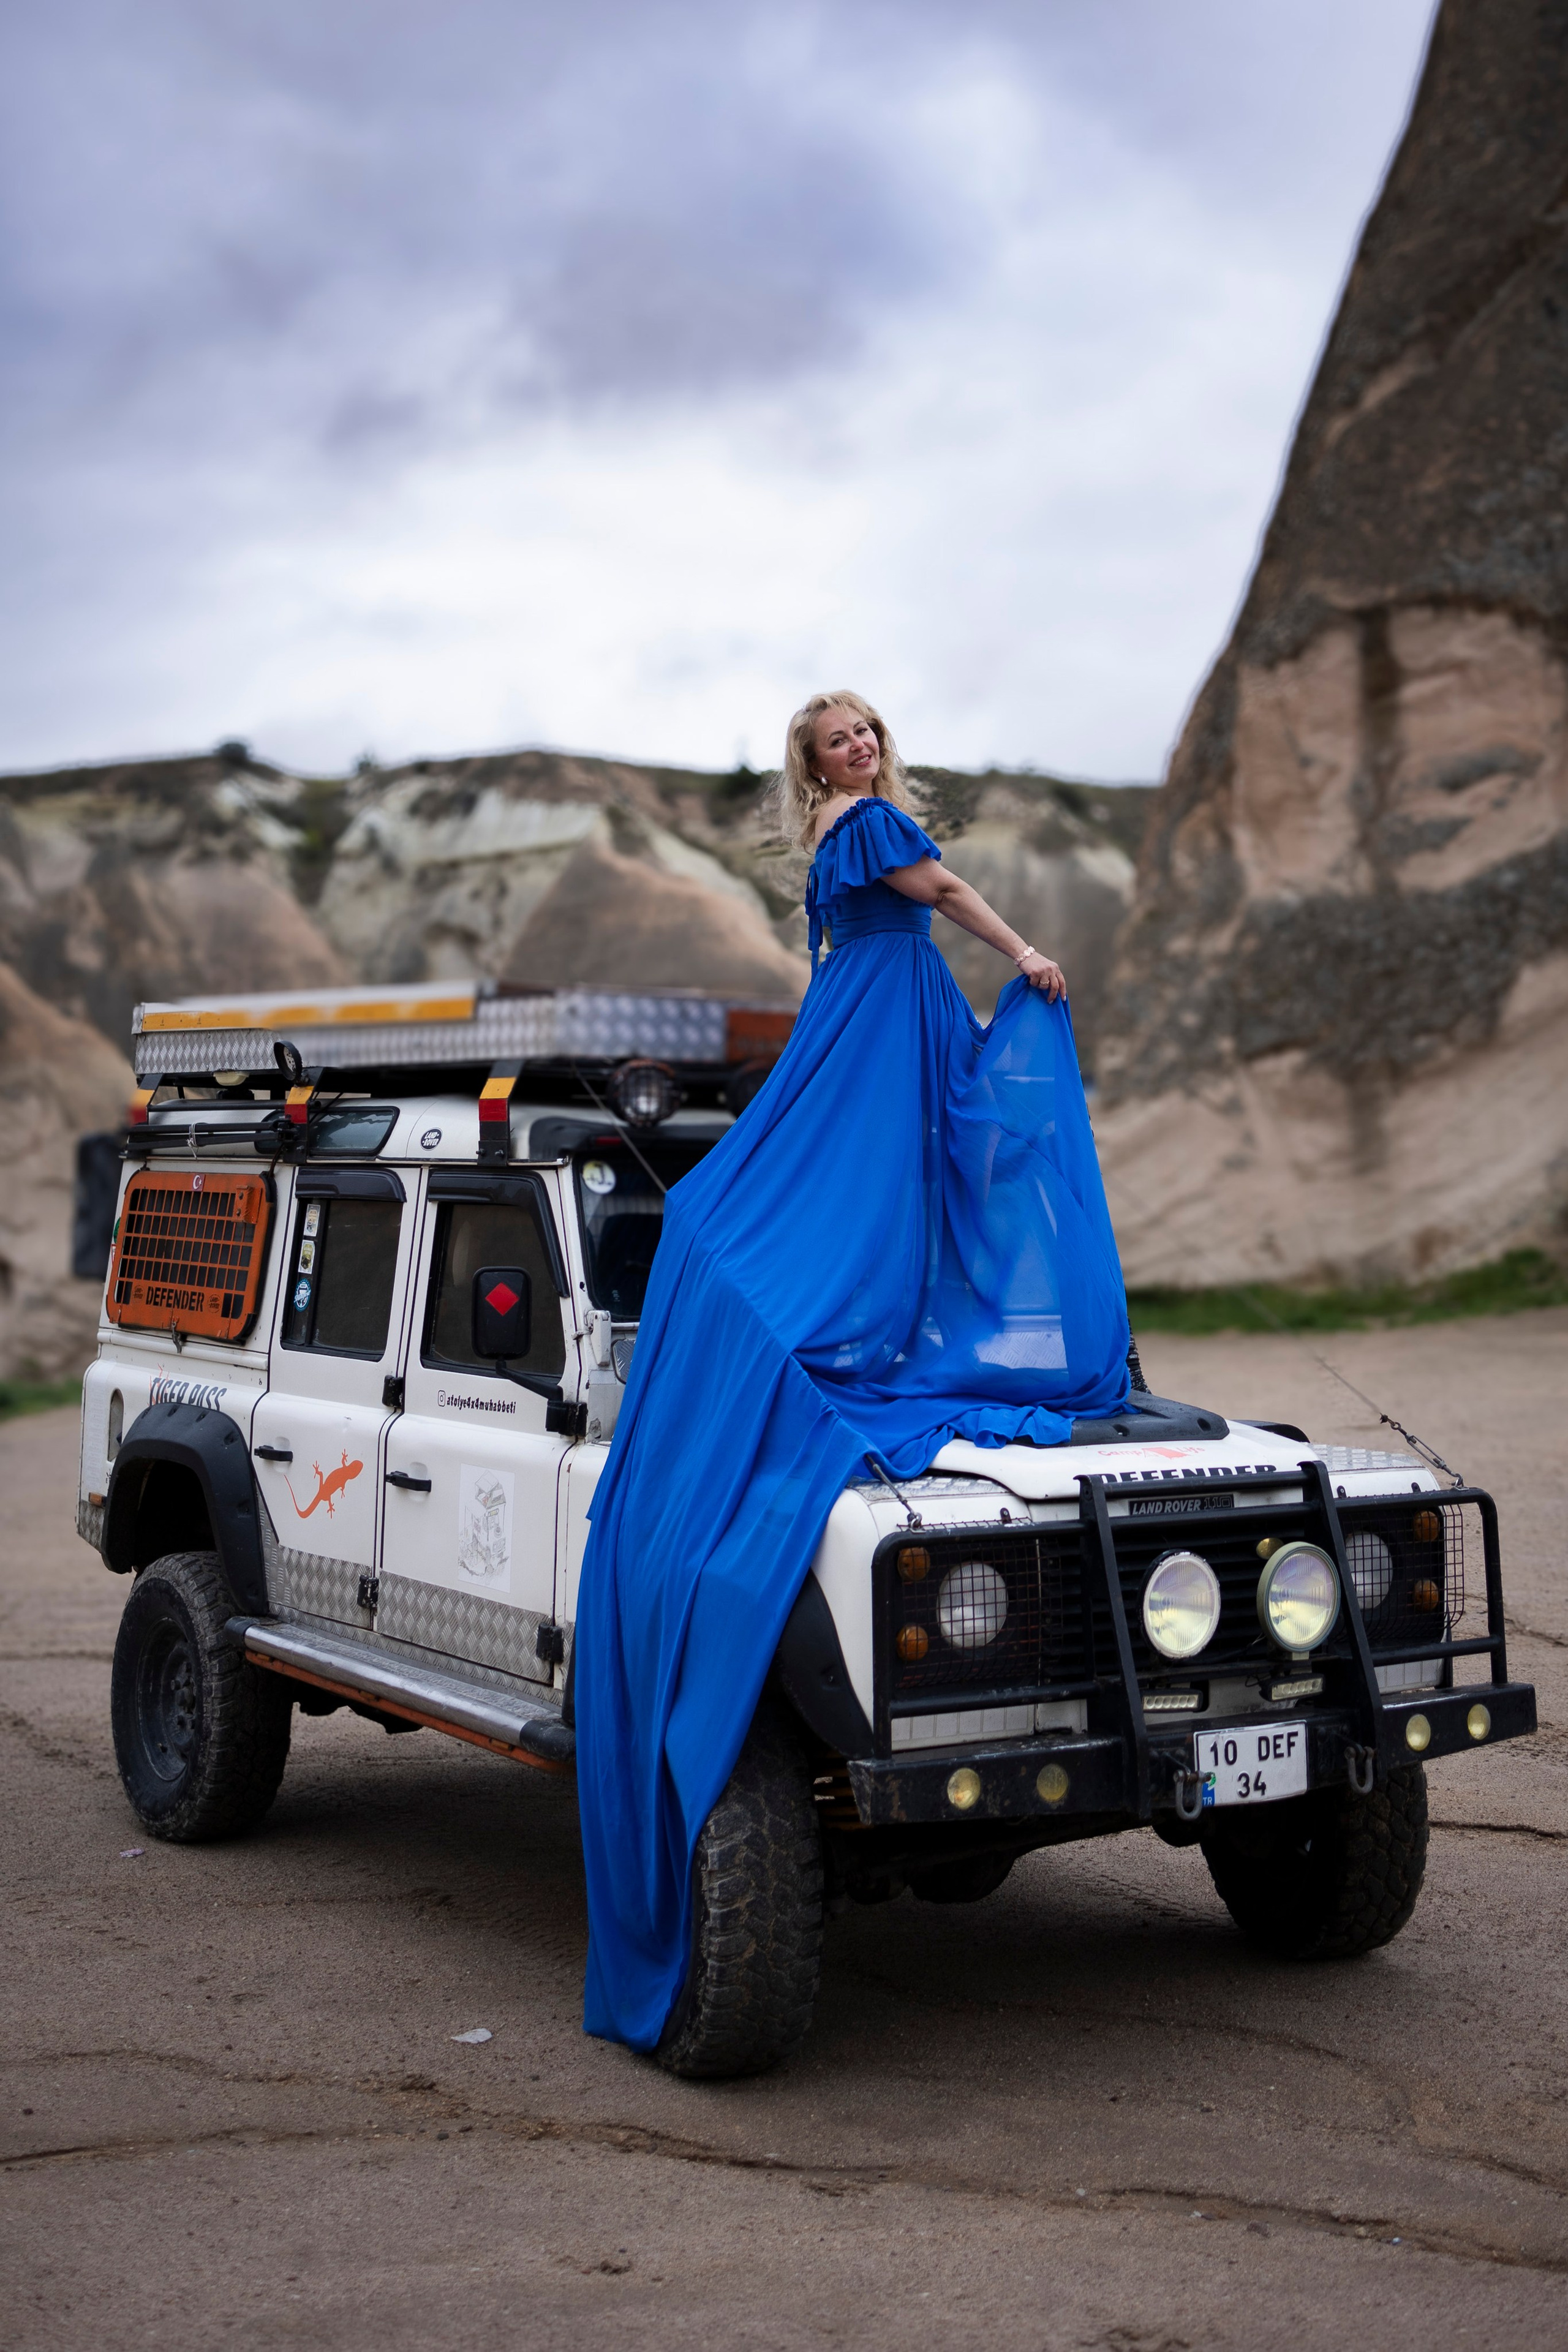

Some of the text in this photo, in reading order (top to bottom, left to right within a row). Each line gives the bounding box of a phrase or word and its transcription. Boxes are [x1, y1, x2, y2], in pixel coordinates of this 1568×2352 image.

[145, 1286, 205, 1312] DEFENDER
[1132, 1496, 1233, 1515] LAND ROVER 110
[1210, 1730, 1298, 1766] 10 DEF
[1237, 1770, 1267, 1798] 34
[1202, 1796, 1212, 1806] TR
